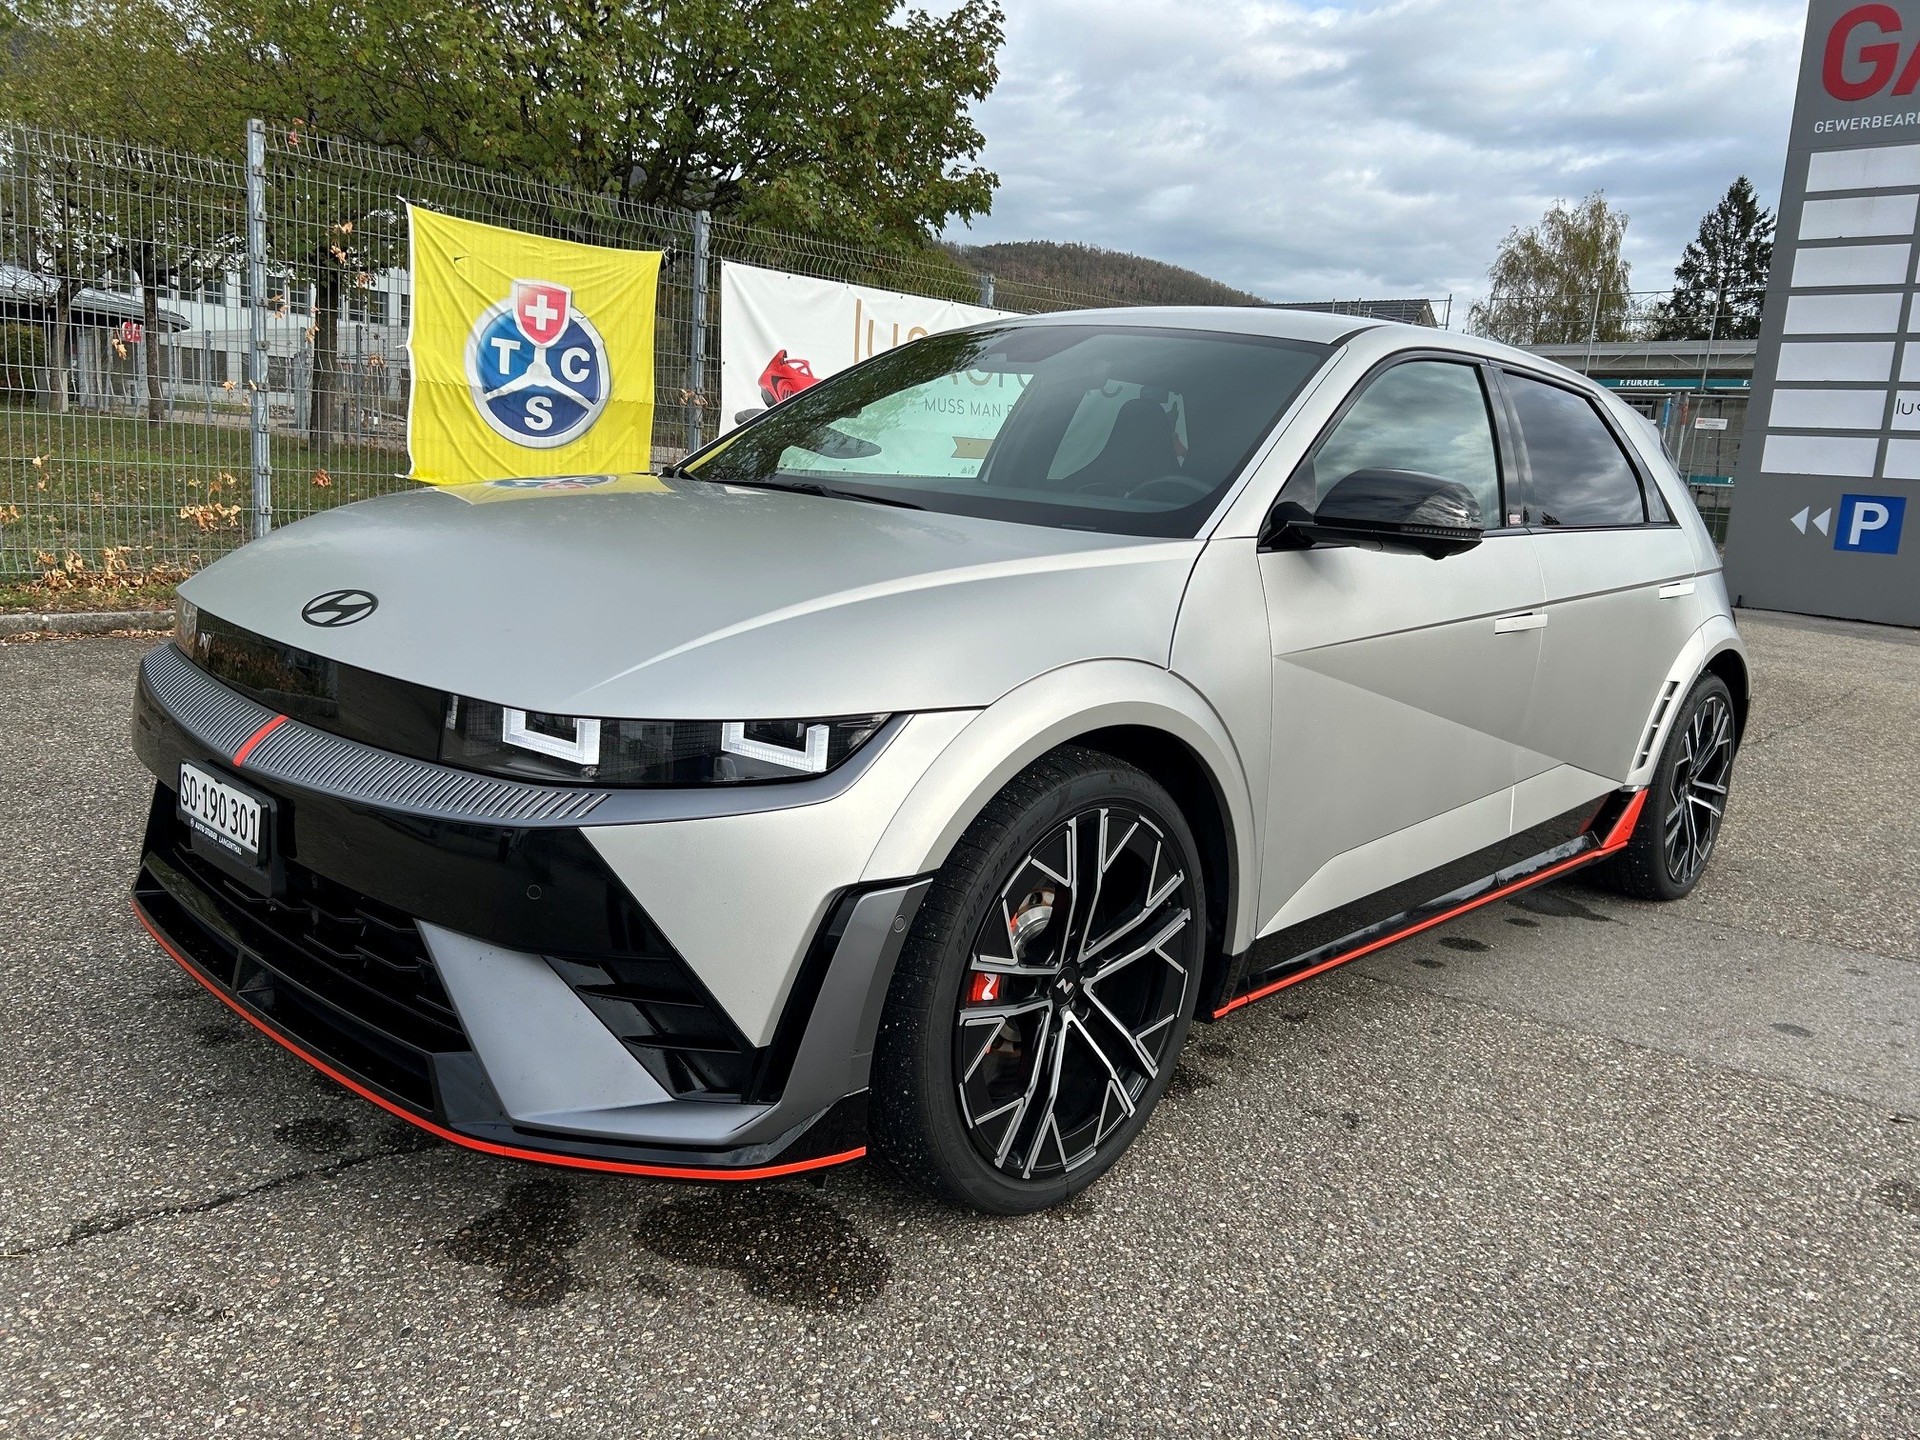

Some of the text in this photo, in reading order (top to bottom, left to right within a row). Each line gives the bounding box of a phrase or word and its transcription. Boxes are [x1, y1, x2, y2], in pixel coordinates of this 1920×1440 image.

[924, 397, 965, 415] MUSS
[970, 402, 1001, 417] MAN
[1849, 502, 1890, 546] P
[230, 798, 258, 848] 301
